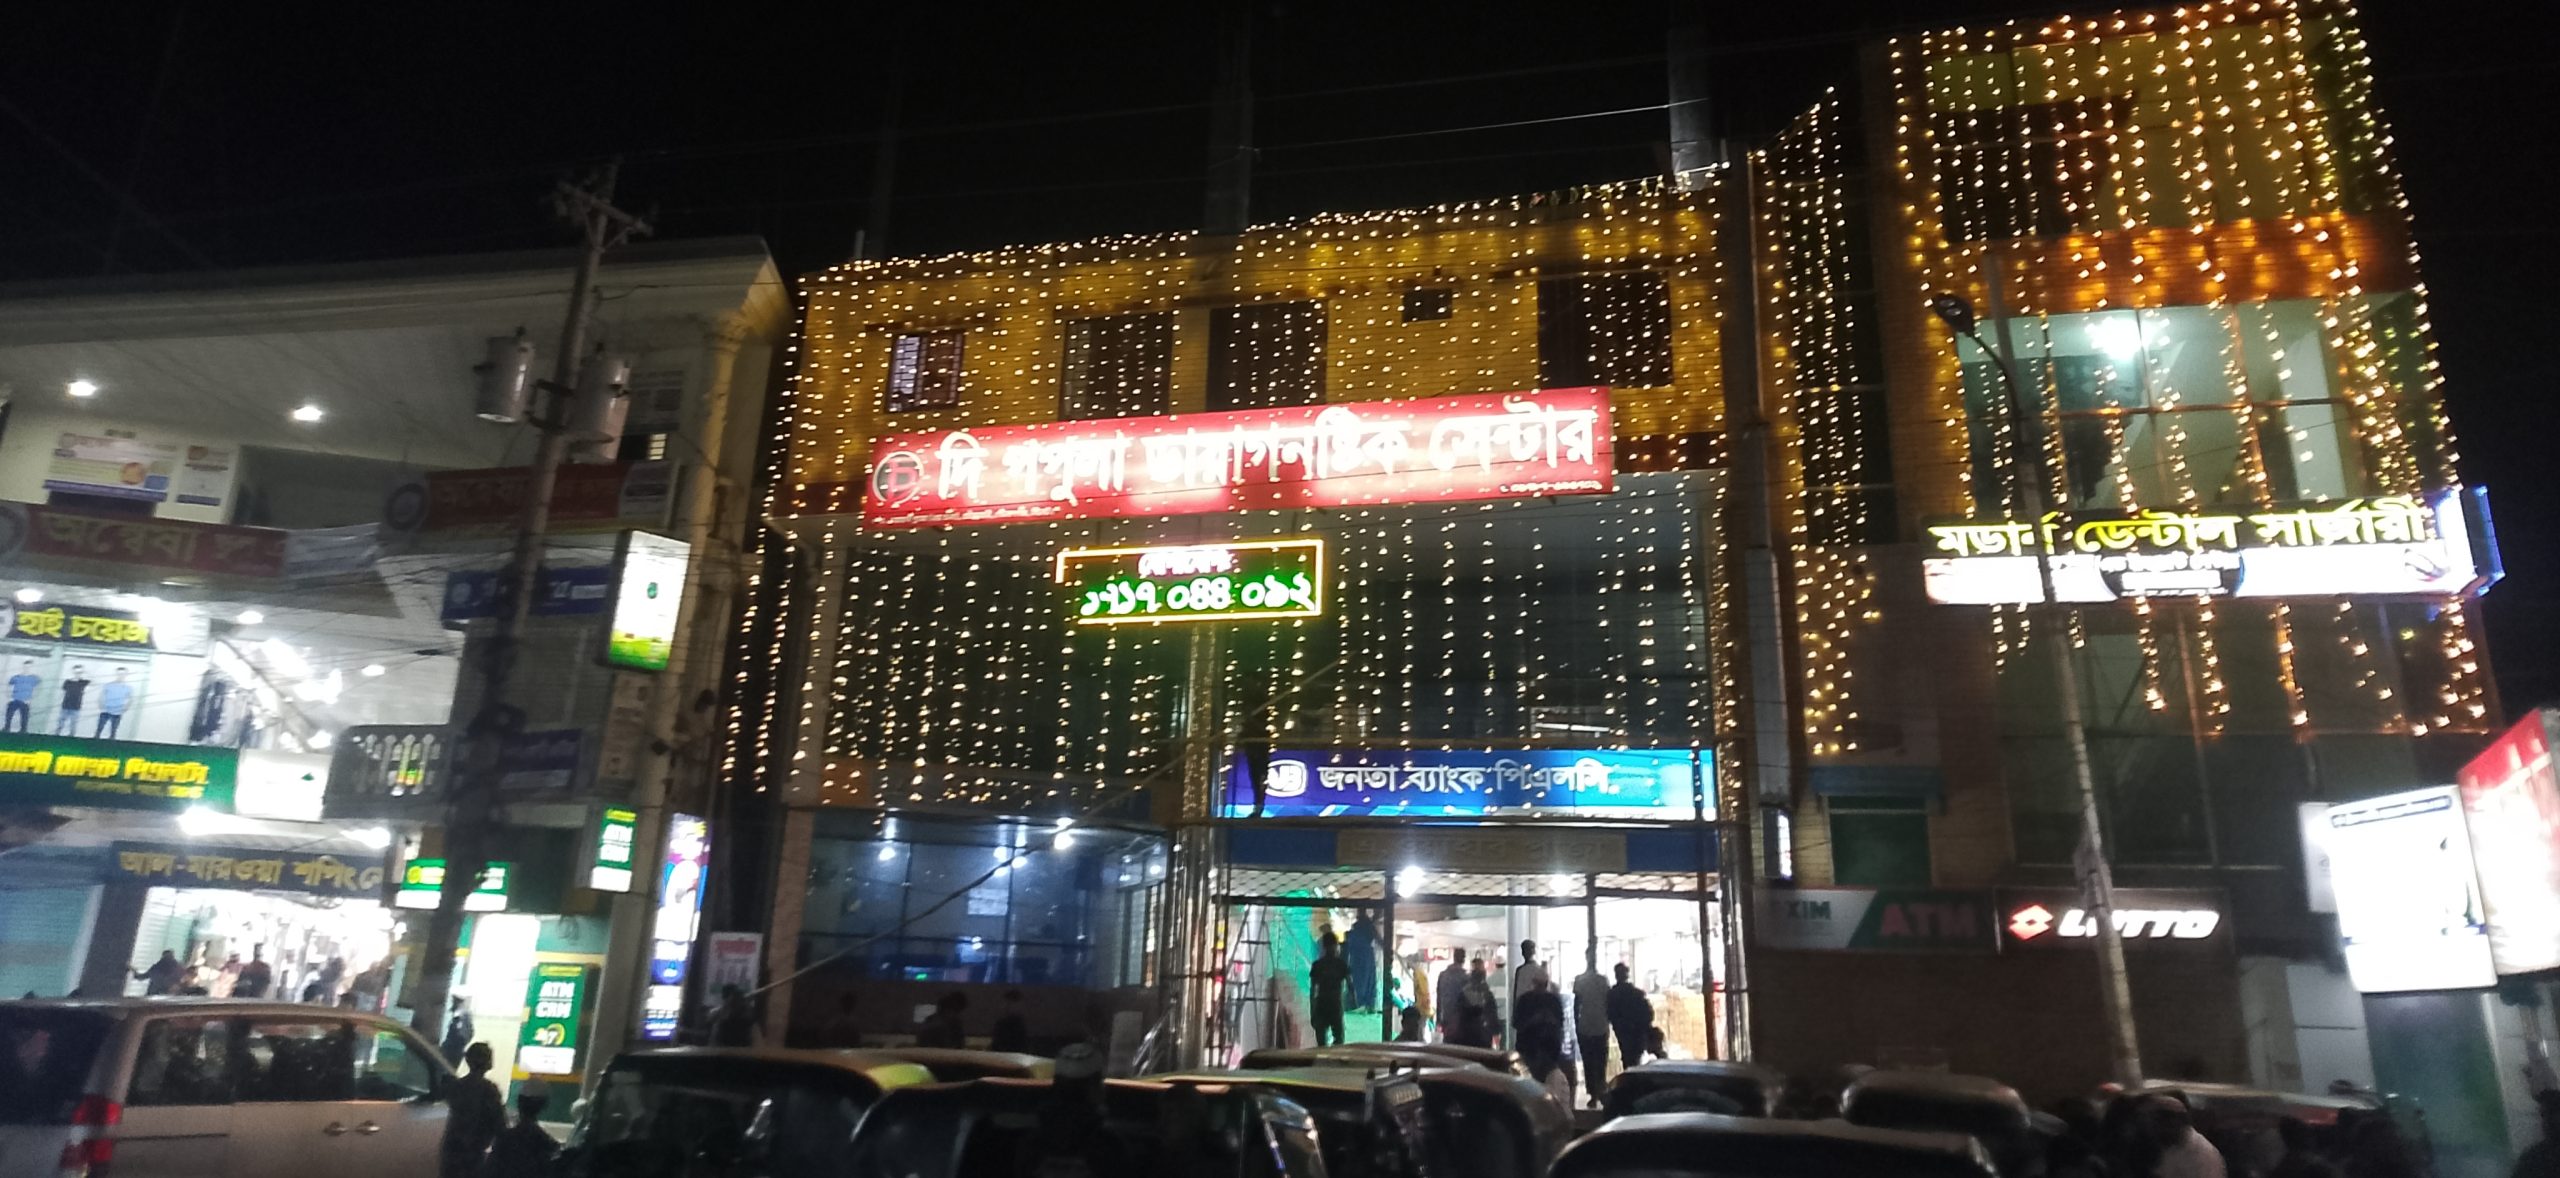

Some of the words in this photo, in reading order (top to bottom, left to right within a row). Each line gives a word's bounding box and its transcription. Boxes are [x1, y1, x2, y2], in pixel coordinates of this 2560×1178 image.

[935, 431, 989, 499] দি
[1429, 396, 1599, 474] সেন্টার
[2075, 509, 2243, 552] ডেন্টাল
[2249, 498, 2427, 547] সার্জারী
[1167, 576, 1231, 610] ০৪৪
[1241, 572, 1316, 611] ০৯২
[17, 607, 65, 638] হাই
[1316, 764, 1397, 793] জনতা
[1404, 764, 1488, 794] ব্যাংক
[1495, 757, 1611, 795] পিএলসি
[540, 981, 575, 998] ATM
